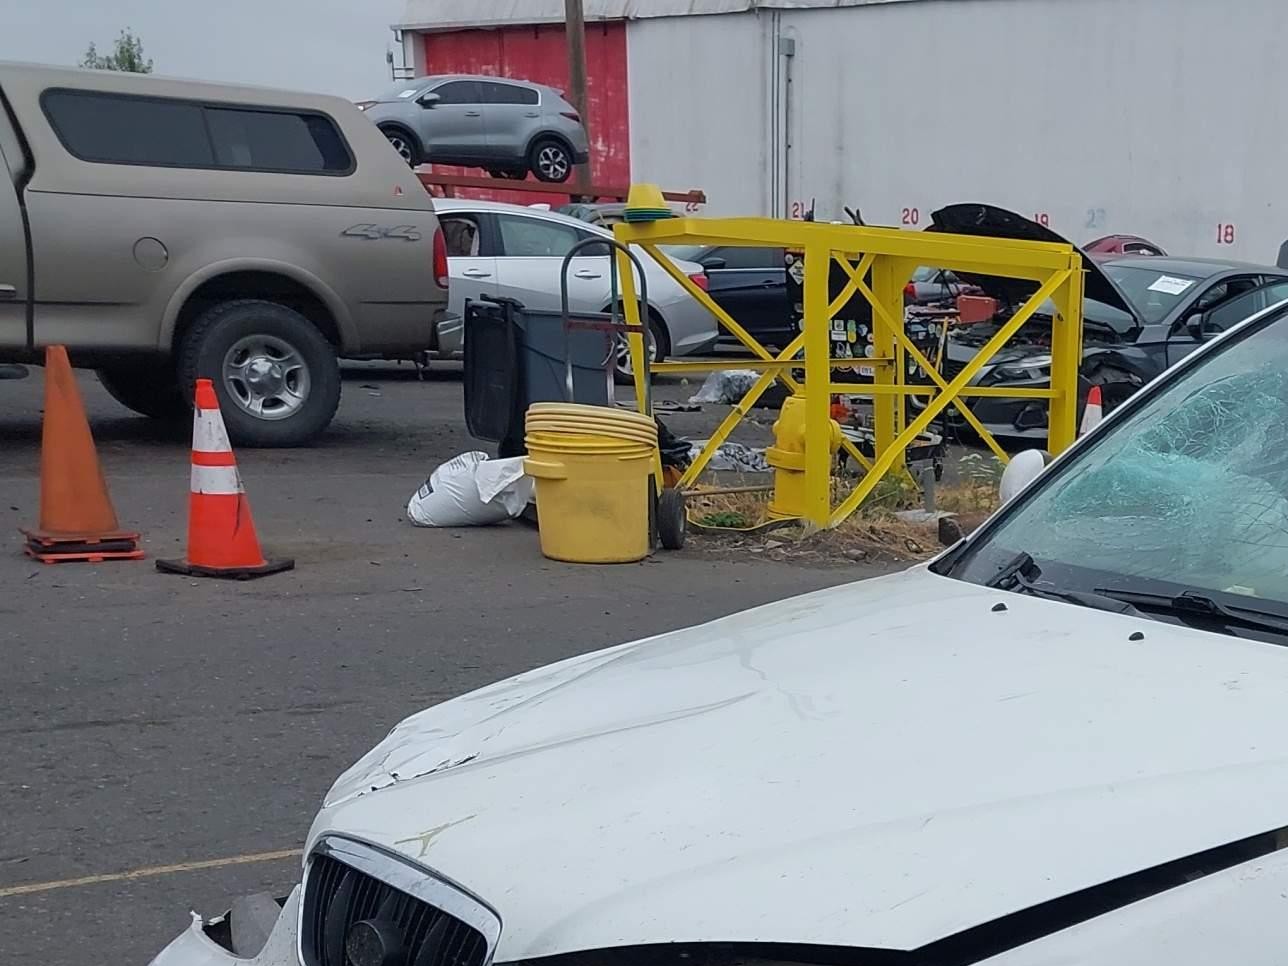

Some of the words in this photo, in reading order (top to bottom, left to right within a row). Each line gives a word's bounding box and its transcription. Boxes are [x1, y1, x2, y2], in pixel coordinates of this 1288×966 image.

[792, 202, 806, 218] 21
[902, 208, 919, 225] 20
[1216, 224, 1234, 244] 18
